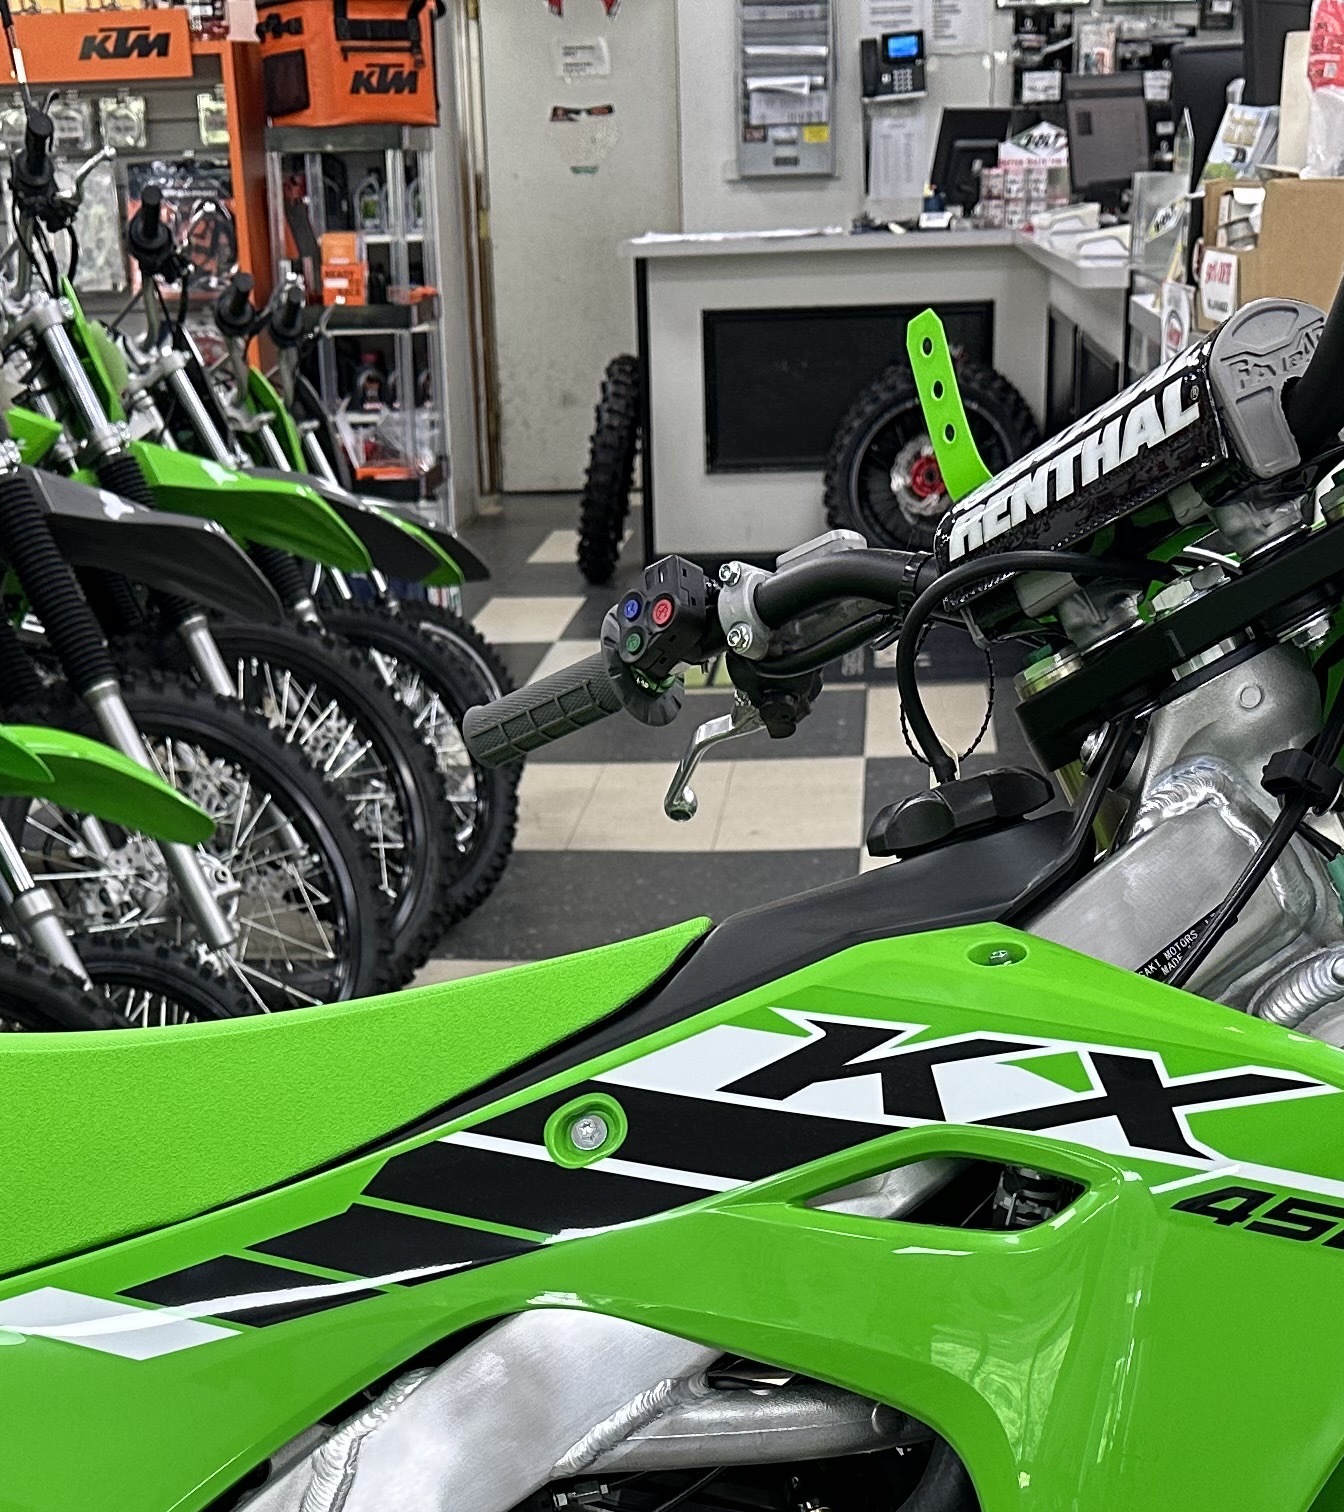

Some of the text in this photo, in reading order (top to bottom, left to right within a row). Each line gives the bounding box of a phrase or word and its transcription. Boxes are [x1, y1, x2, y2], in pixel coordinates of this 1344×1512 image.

[79, 26, 171, 61] KTM
[350, 63, 419, 95] KTM
[948, 386, 1201, 563] RENTHAL
[1163, 929, 1198, 960] MOTORS
[716, 1018, 1328, 1162] KX
